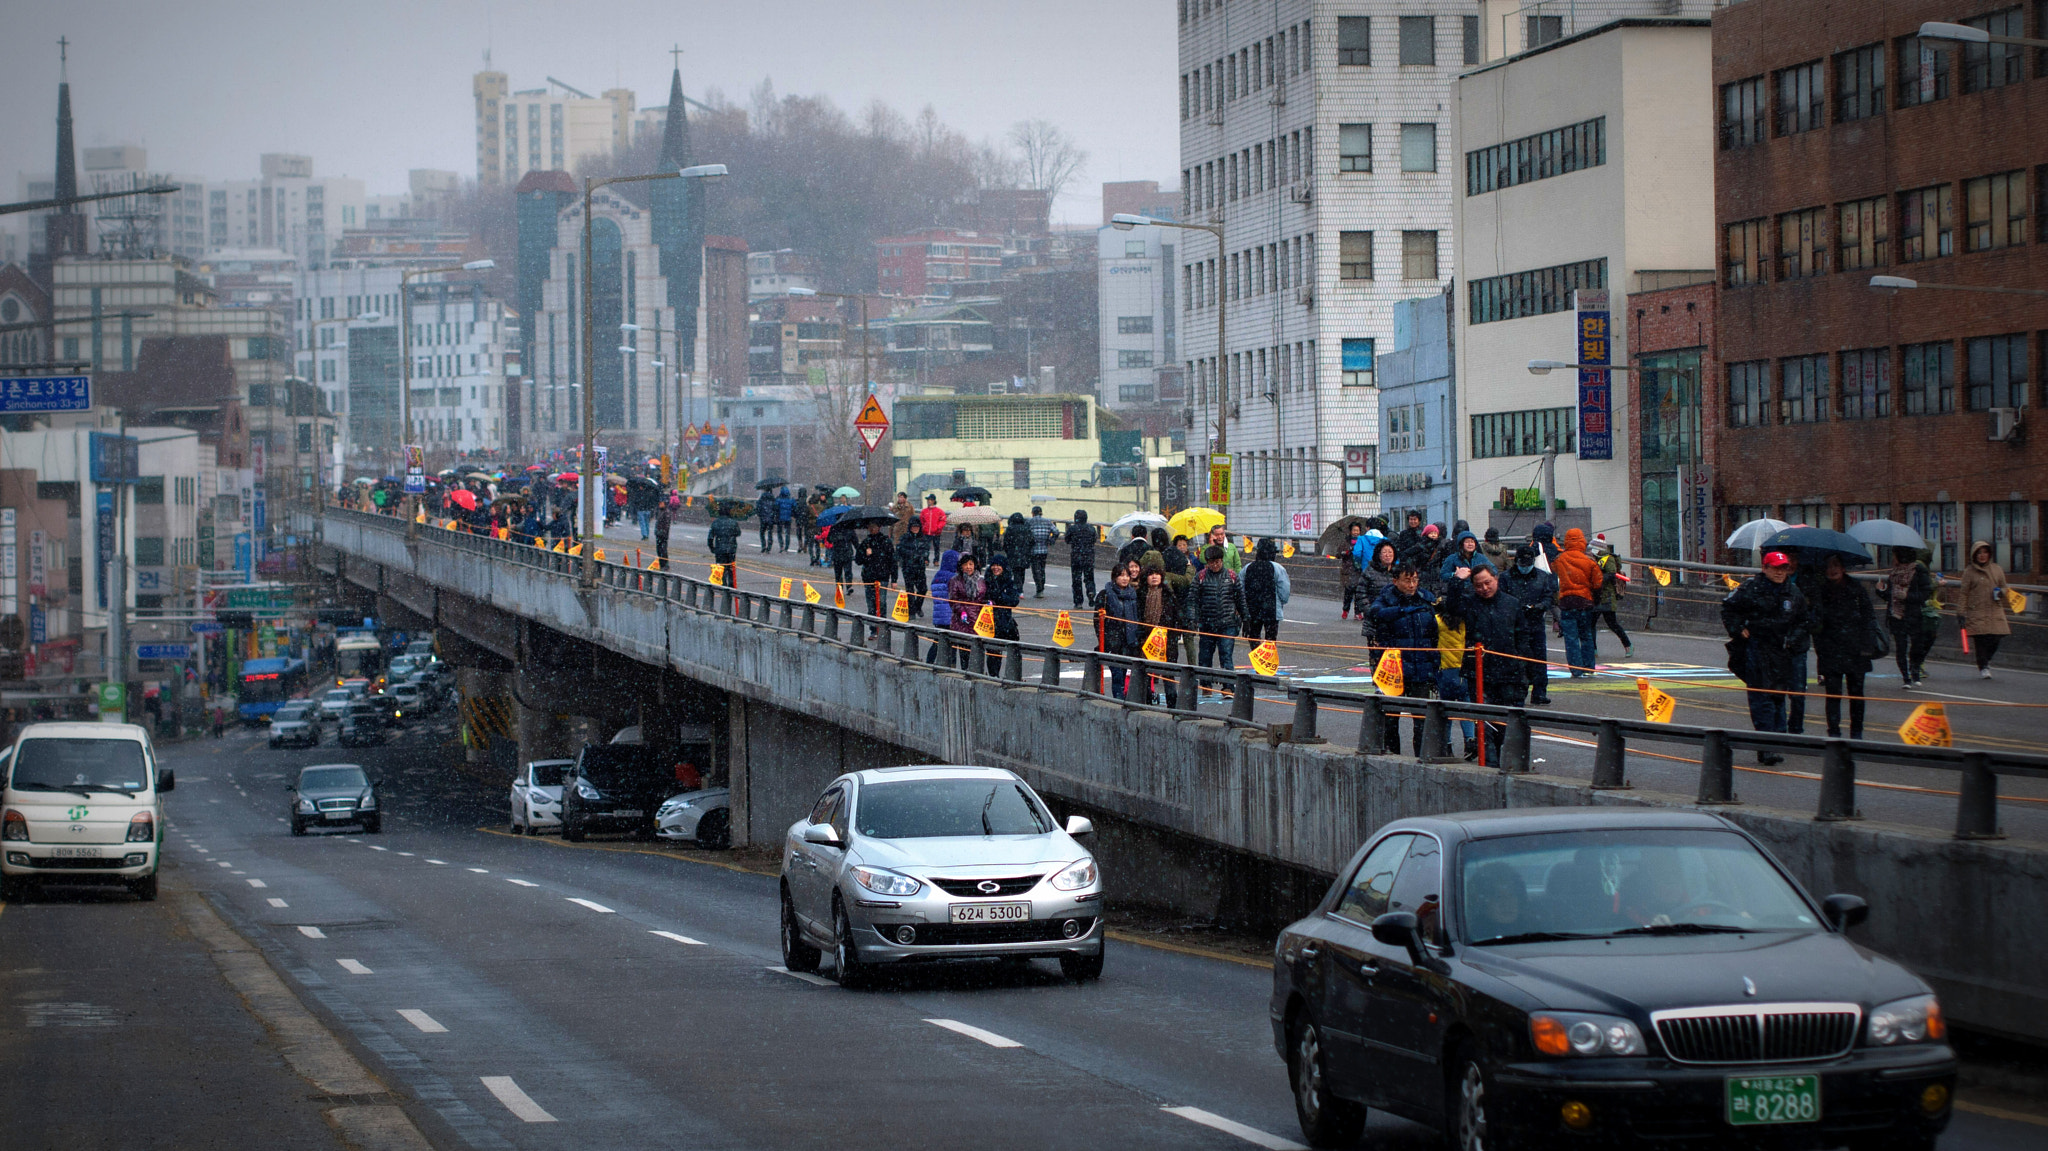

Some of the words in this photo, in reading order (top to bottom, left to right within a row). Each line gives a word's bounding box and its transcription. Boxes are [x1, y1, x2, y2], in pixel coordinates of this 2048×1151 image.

[5, 400, 57, 410] Sinchon-ro
[60, 399, 86, 410] 33-gil
[1346, 450, 1369, 474] 약
[1293, 512, 1311, 531] 임대
[958, 907, 983, 921] 62서
[989, 906, 1022, 920] 5300
[1733, 1094, 1751, 1114] 라
[1754, 1092, 1815, 1121] 8288
